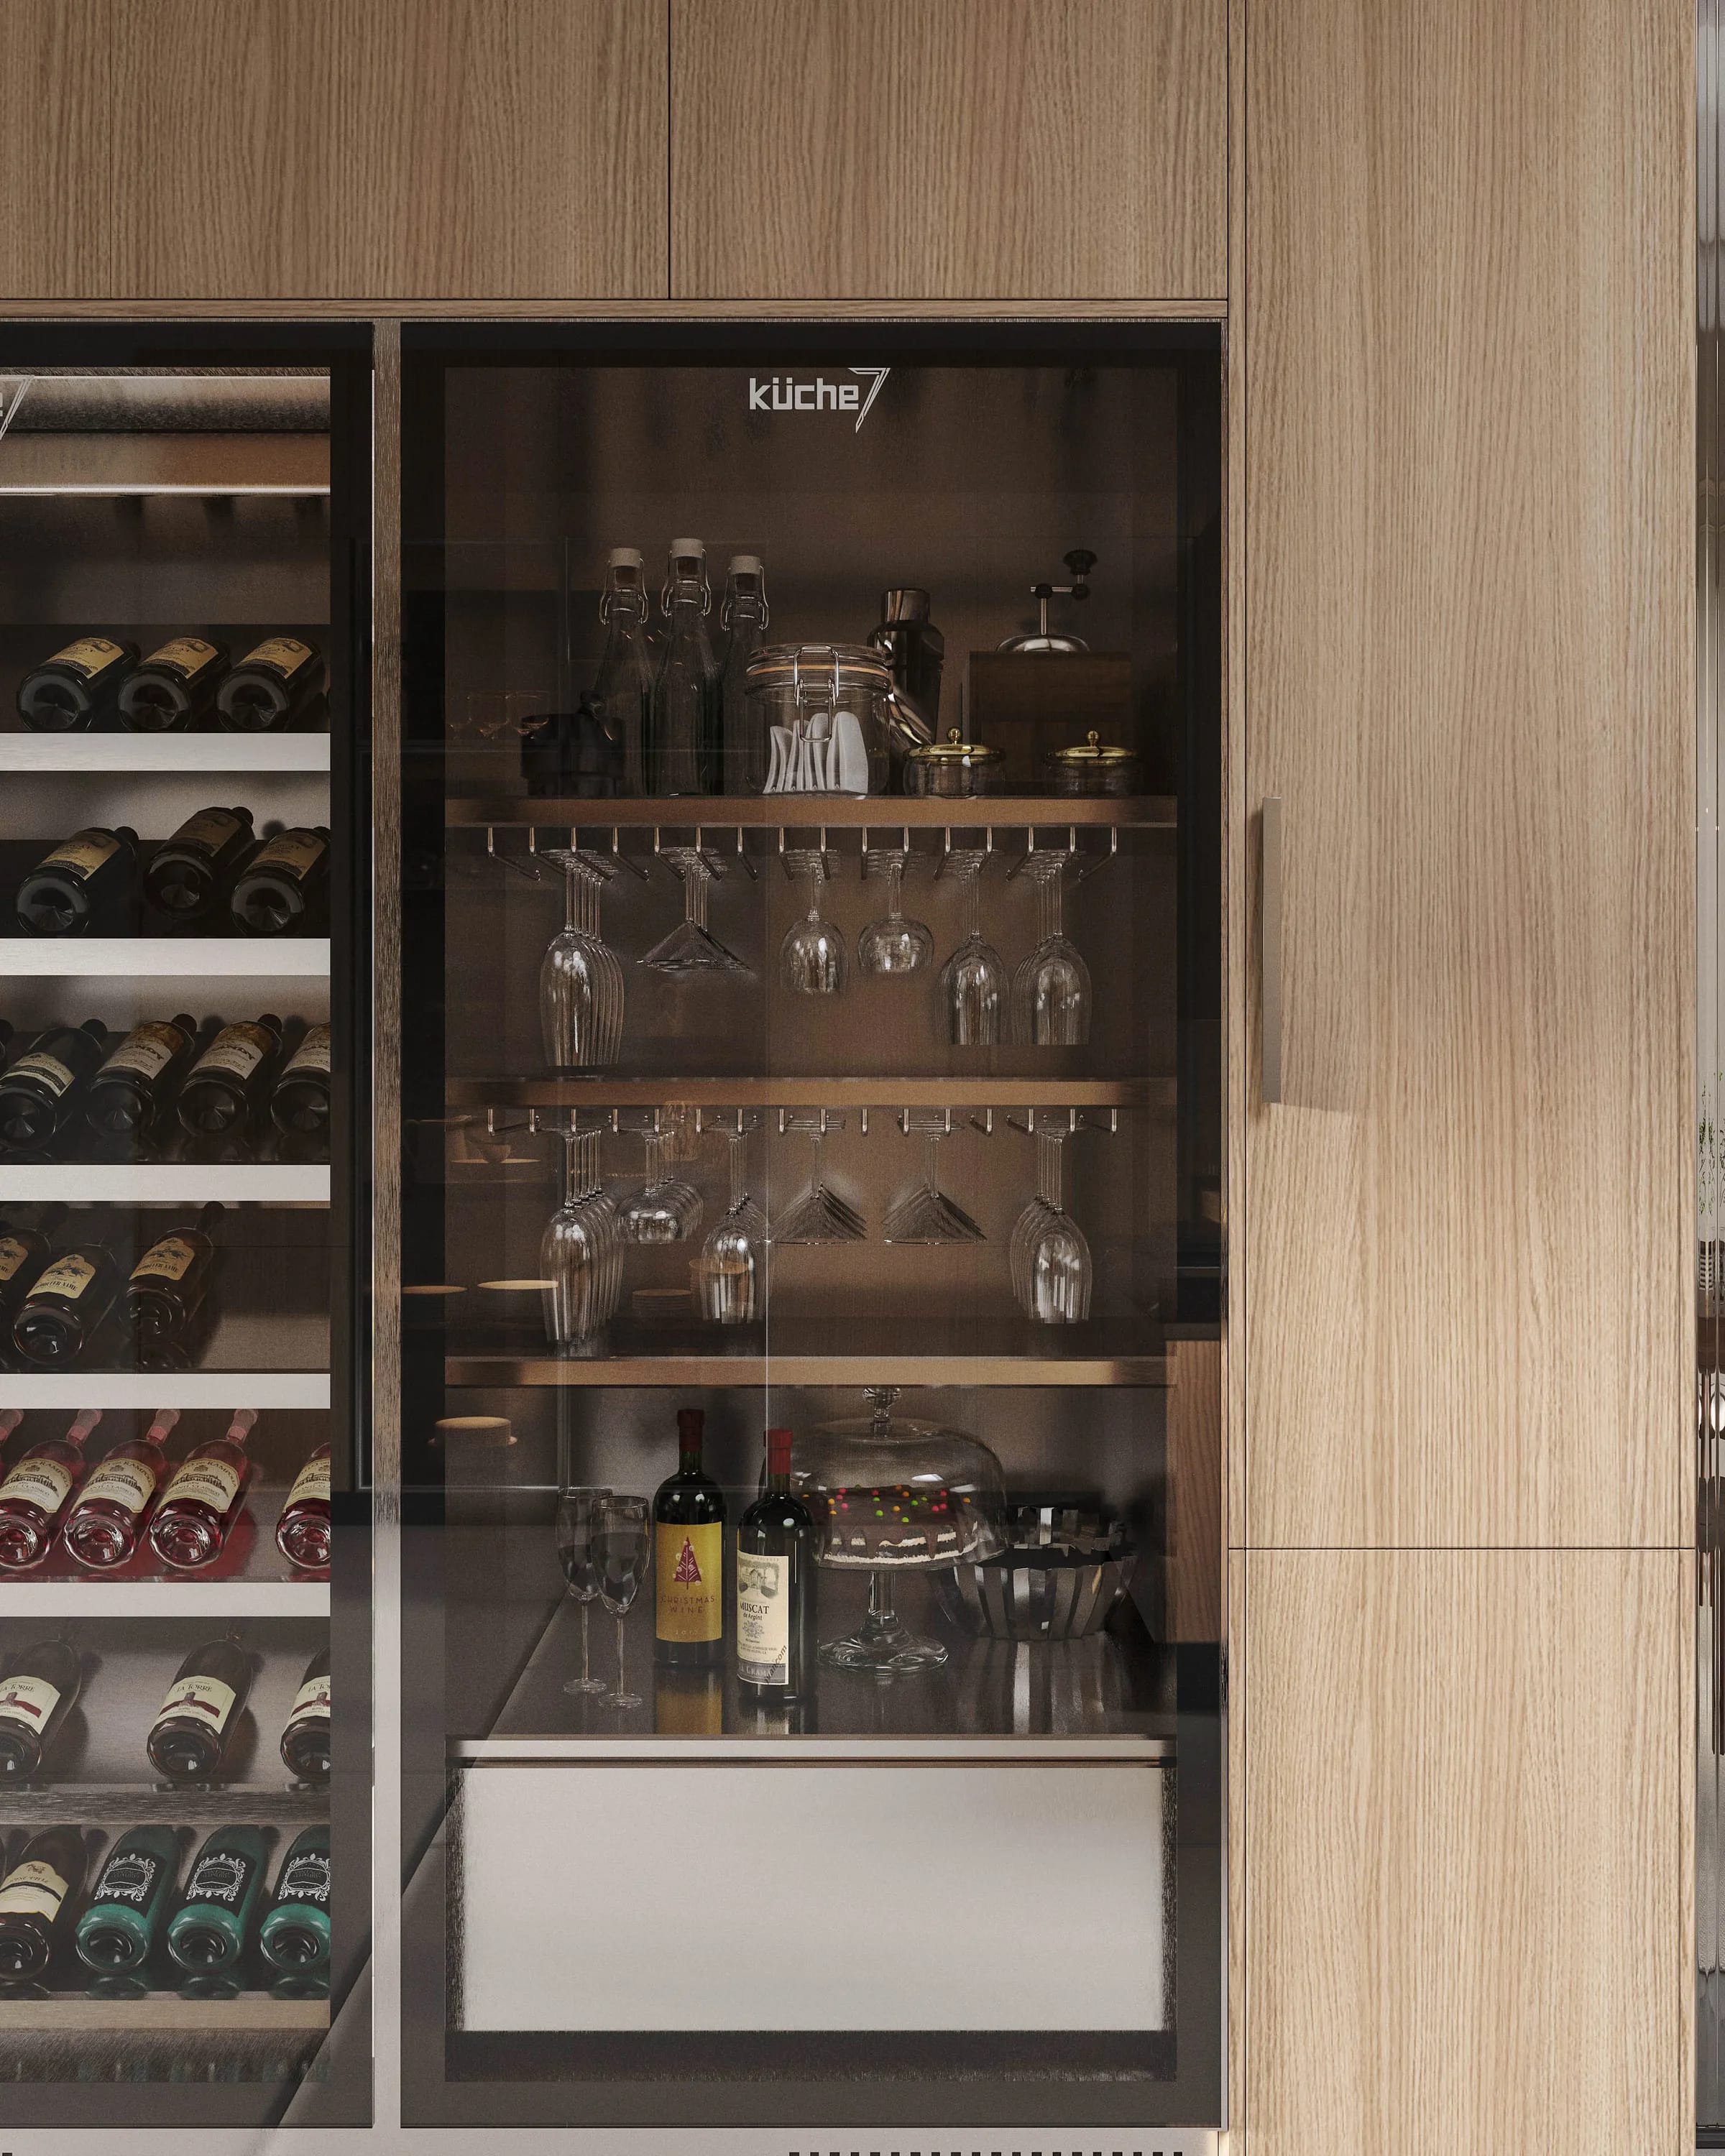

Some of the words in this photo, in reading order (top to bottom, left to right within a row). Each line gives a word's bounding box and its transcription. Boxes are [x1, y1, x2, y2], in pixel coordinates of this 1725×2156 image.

[661, 1595, 715, 1605] CHRISTMAS
[669, 1606, 704, 1614] WINE
[740, 1602, 770, 1615] MUSCAT
[11, 1683, 35, 1692] TORRE
[188, 1683, 213, 1692] TORRE
